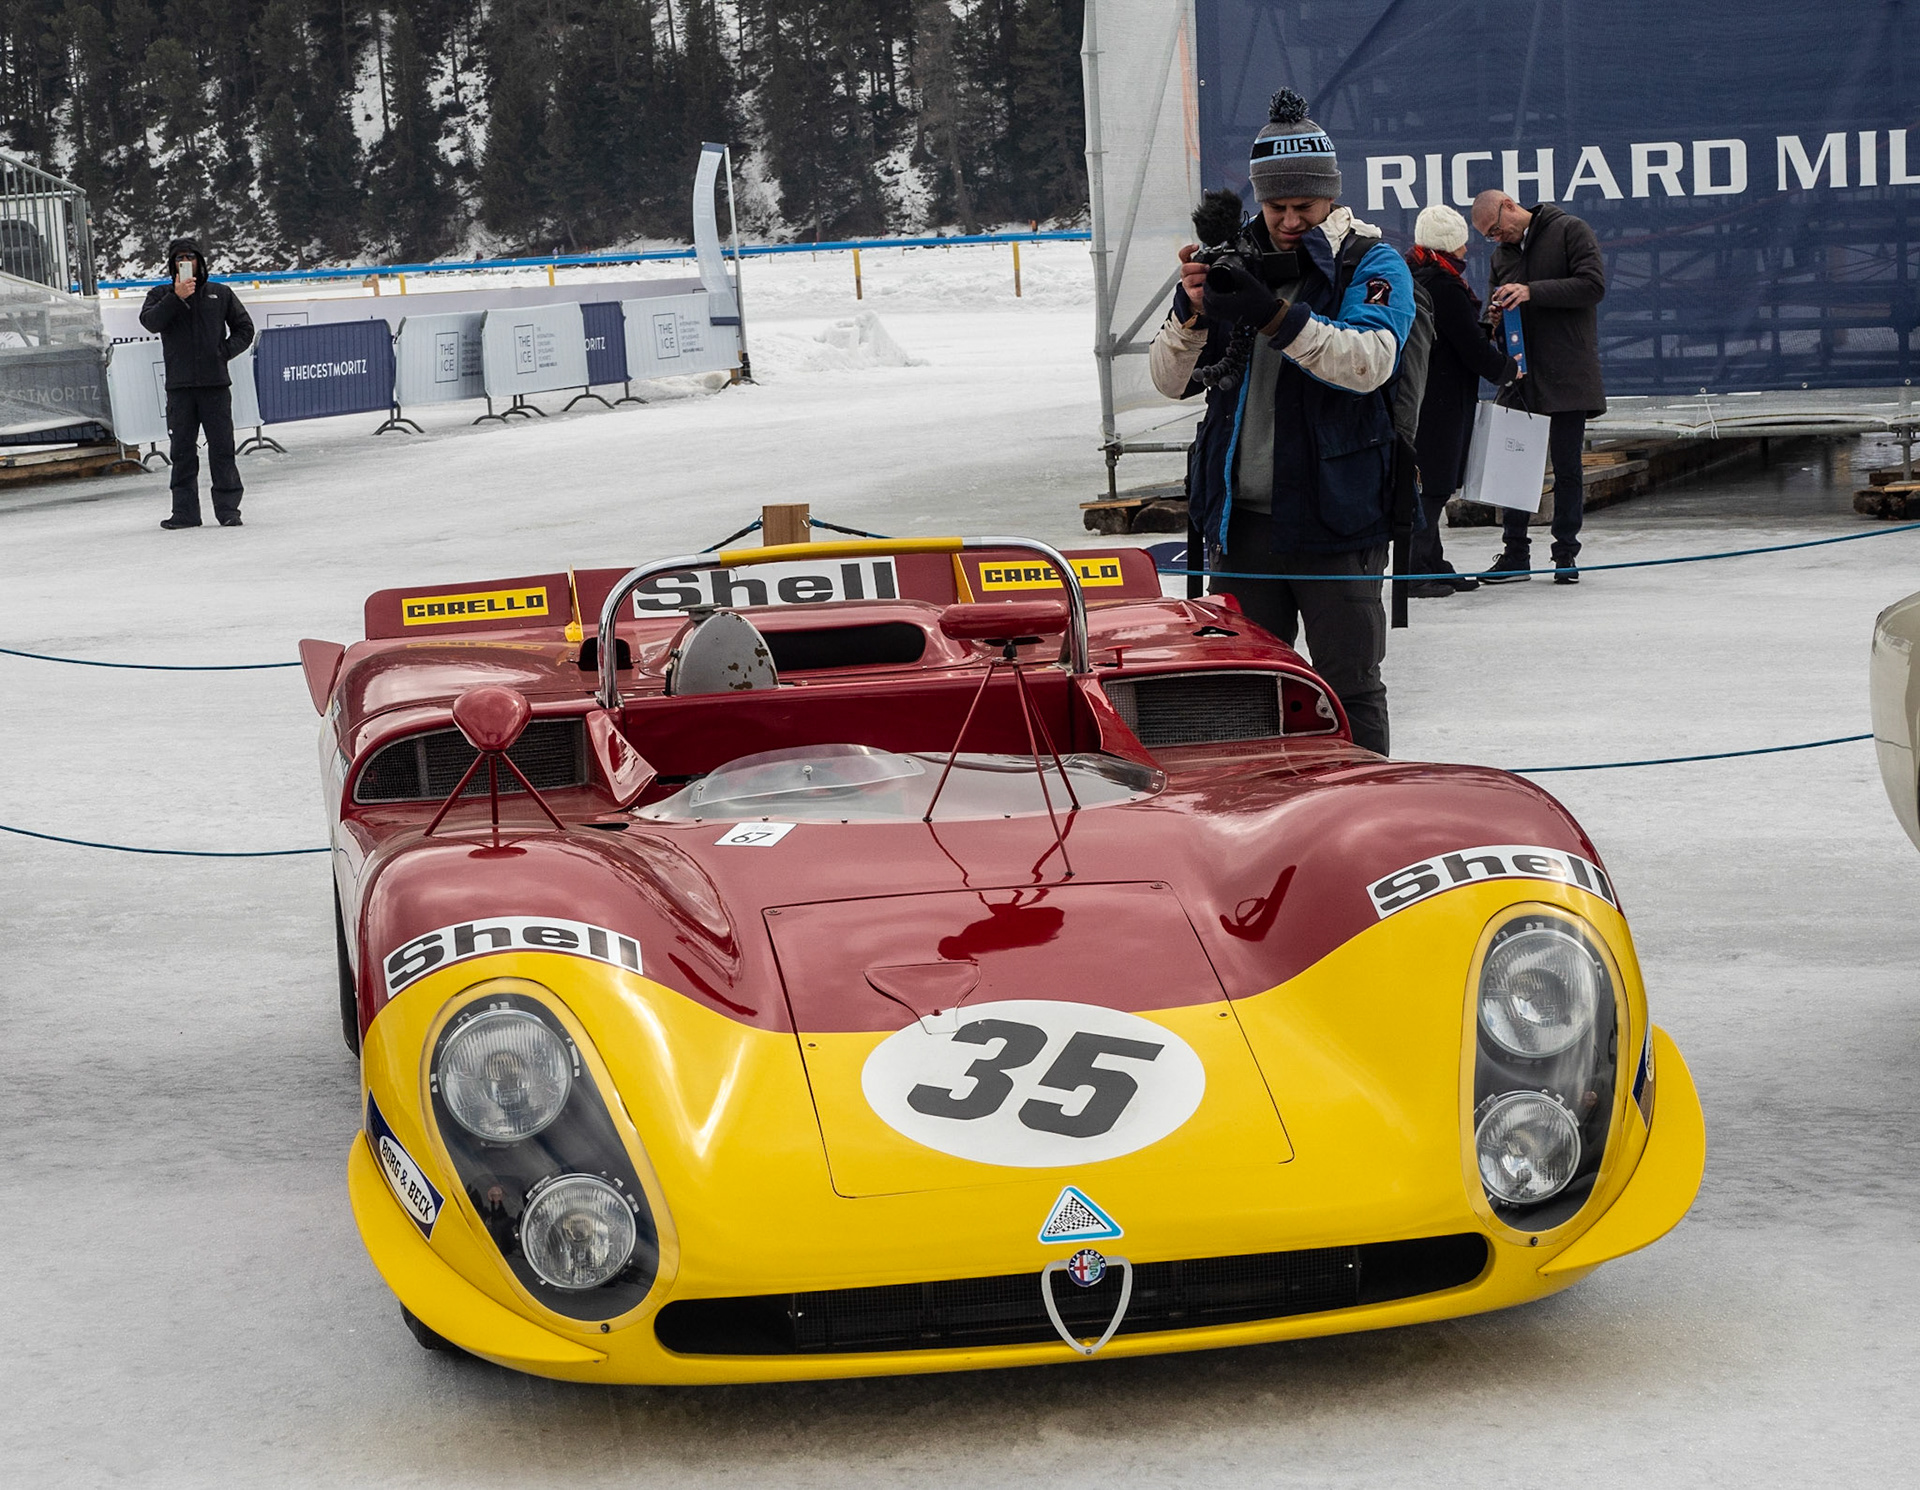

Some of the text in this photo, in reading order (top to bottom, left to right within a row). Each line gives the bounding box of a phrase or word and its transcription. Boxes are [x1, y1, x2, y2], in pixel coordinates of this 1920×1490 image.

[1366, 129, 1920, 210] RICHARD MIL
[658, 323, 673, 335] THE
[440, 343, 454, 356] THE
[518, 335, 531, 347] THE
[661, 337, 675, 349] ICE
[441, 359, 454, 371] ICE
[521, 351, 532, 363] ICE
[283, 359, 367, 381] #THEICESTMORITZ
[985, 565, 1118, 583] CARELO
[637, 562, 896, 611] Shell
[407, 594, 544, 618] CARELLO
[730, 832, 774, 843] 67
[1374, 853, 1616, 912] Shell
[387, 923, 639, 989] Shell
[906, 1018, 1165, 1138] 35
[382, 1139, 433, 1221] BORG & BECK
[1053, 1209, 1087, 1231] AUTODELTA
[1069, 1249, 1105, 1271] ALFA ROMEO
